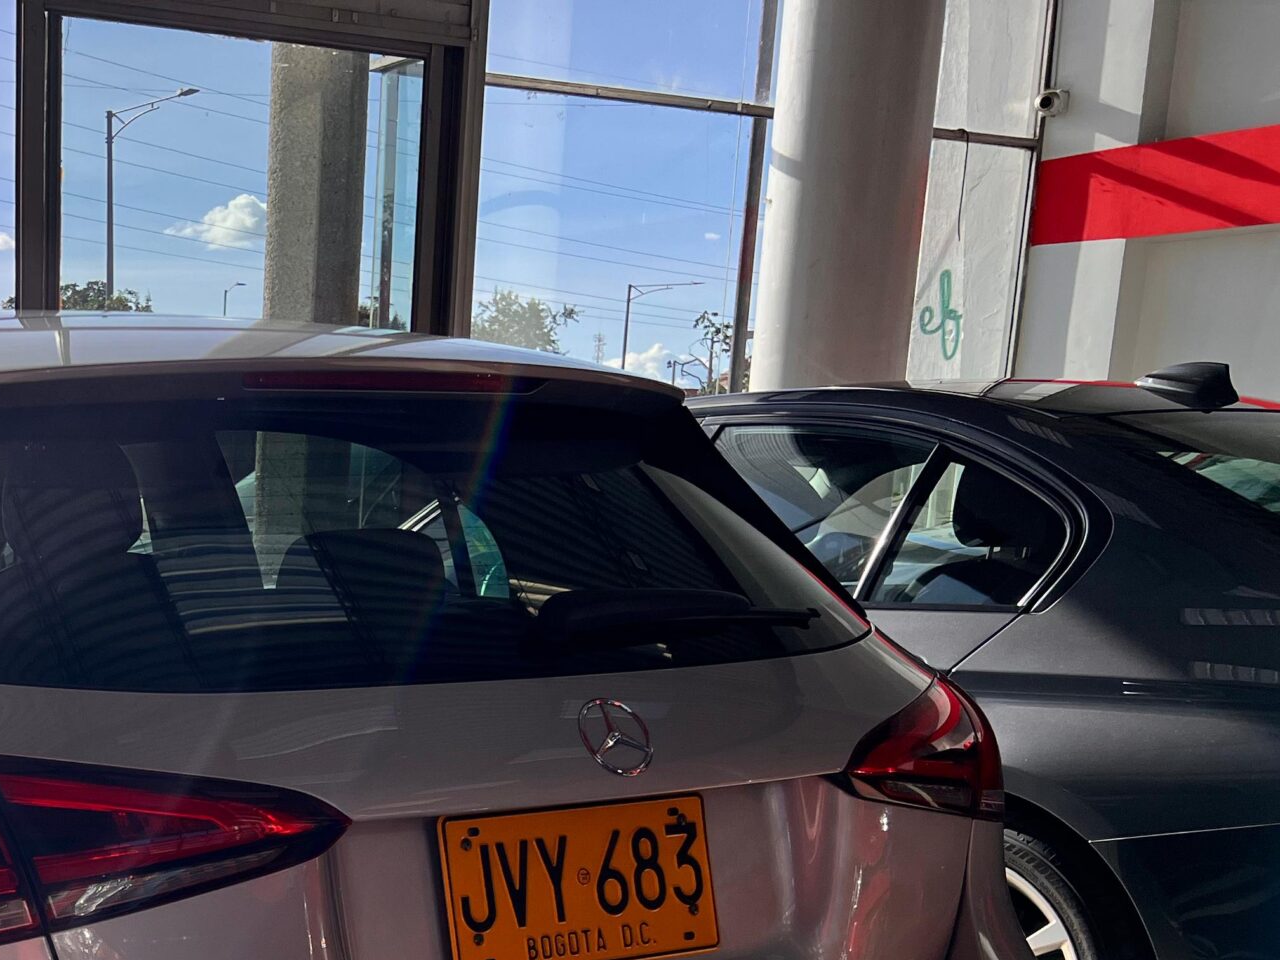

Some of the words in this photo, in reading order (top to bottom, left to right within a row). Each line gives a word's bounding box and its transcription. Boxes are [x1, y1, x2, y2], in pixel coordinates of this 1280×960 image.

[461, 836, 567, 932] JVY
[596, 823, 704, 917] 683
[622, 922, 658, 949] D.C.
